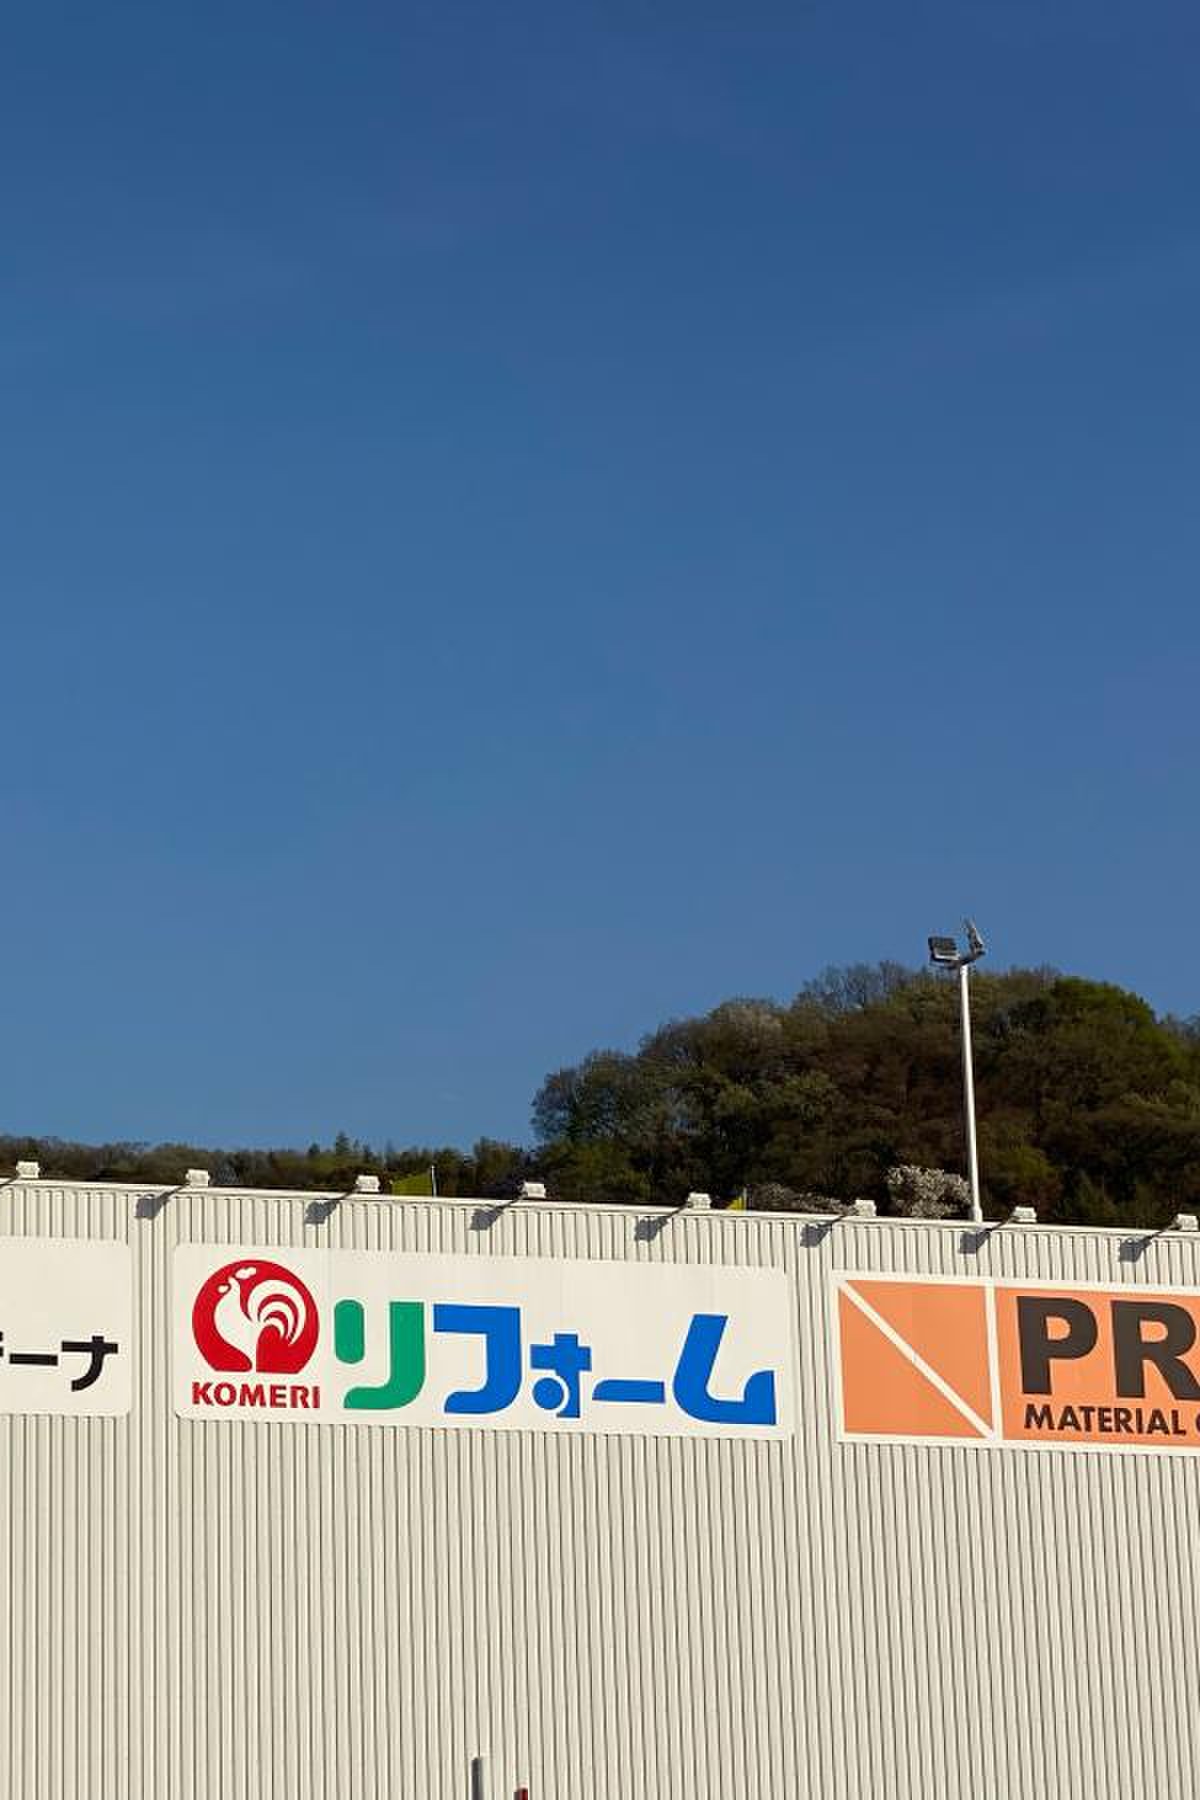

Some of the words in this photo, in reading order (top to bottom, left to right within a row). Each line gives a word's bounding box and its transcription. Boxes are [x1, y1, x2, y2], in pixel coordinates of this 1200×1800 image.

[334, 1299, 778, 1426] リフォーム
[1017, 1295, 1200, 1401] PR
[191, 1380, 321, 1410] KOMERI
[1023, 1403, 1187, 1436] MATERIAL
